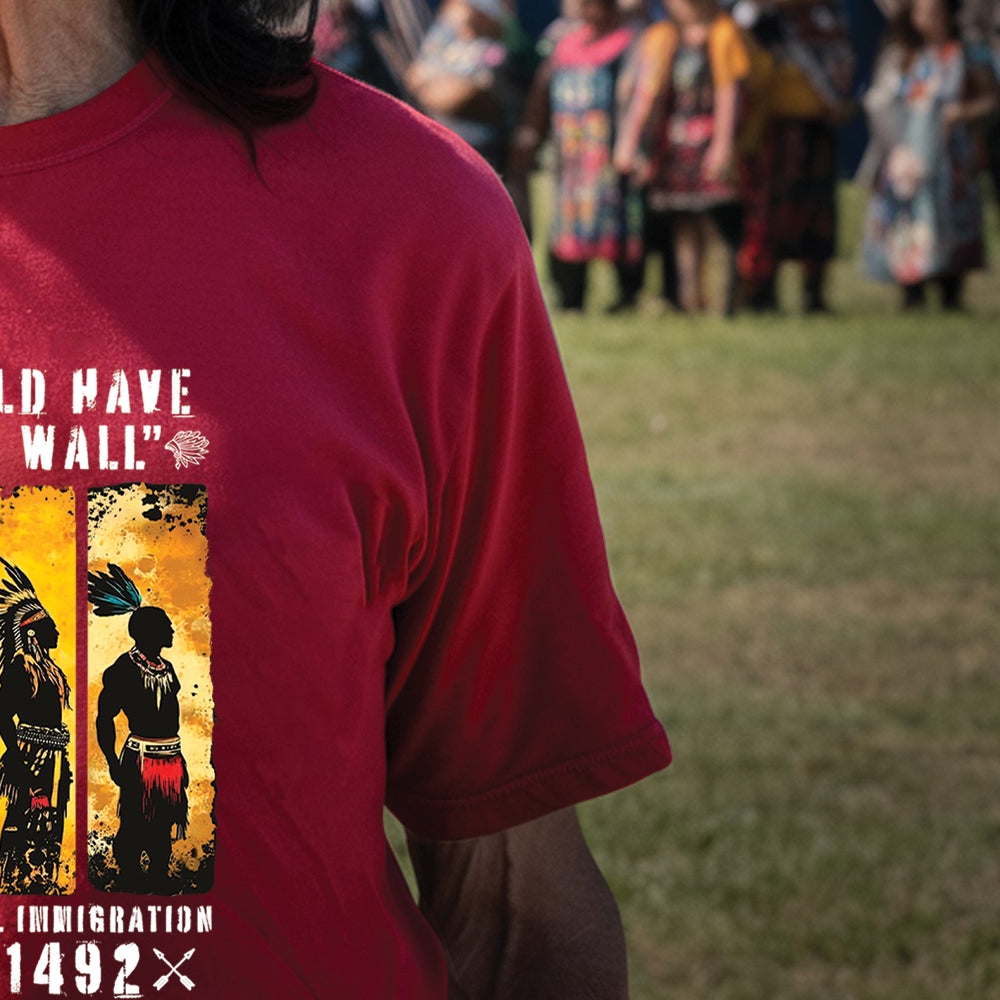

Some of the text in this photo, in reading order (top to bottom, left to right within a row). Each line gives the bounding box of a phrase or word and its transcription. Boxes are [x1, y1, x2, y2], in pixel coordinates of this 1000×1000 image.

[72, 368, 196, 418] HAVE
[21, 424, 162, 471] WALL”
[17, 904, 213, 934] IMMIGRATION
[6, 940, 143, 998] 1492
